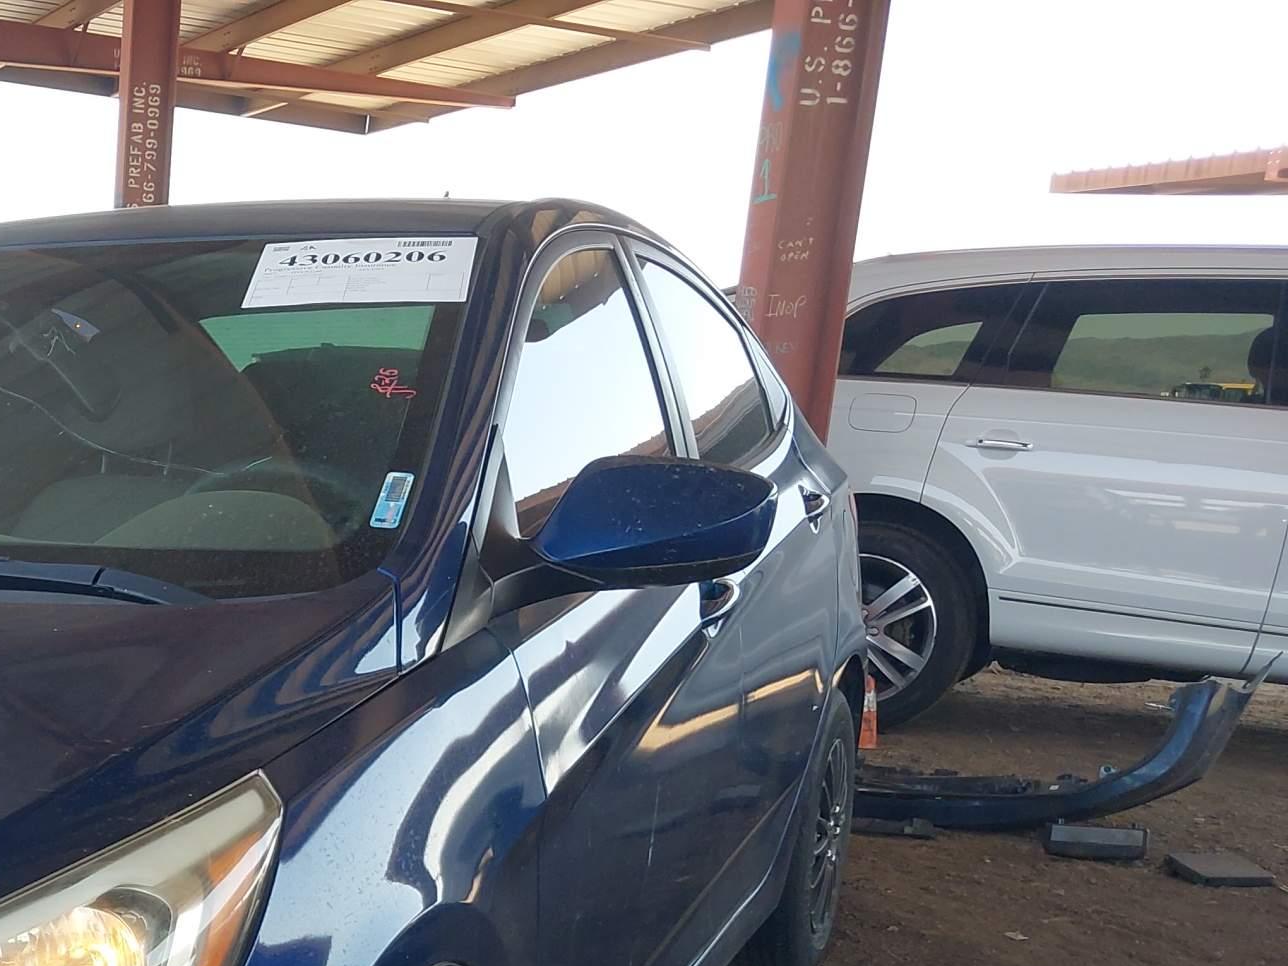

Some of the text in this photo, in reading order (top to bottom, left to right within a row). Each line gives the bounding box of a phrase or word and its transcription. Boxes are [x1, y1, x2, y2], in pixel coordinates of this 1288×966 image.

[132, 81, 146, 114] INC.
[799, 46, 828, 106] U.S.
[127, 122, 144, 188] PREFAB
[142, 84, 161, 205] 66-799-0969
[279, 250, 447, 267] 43060206
